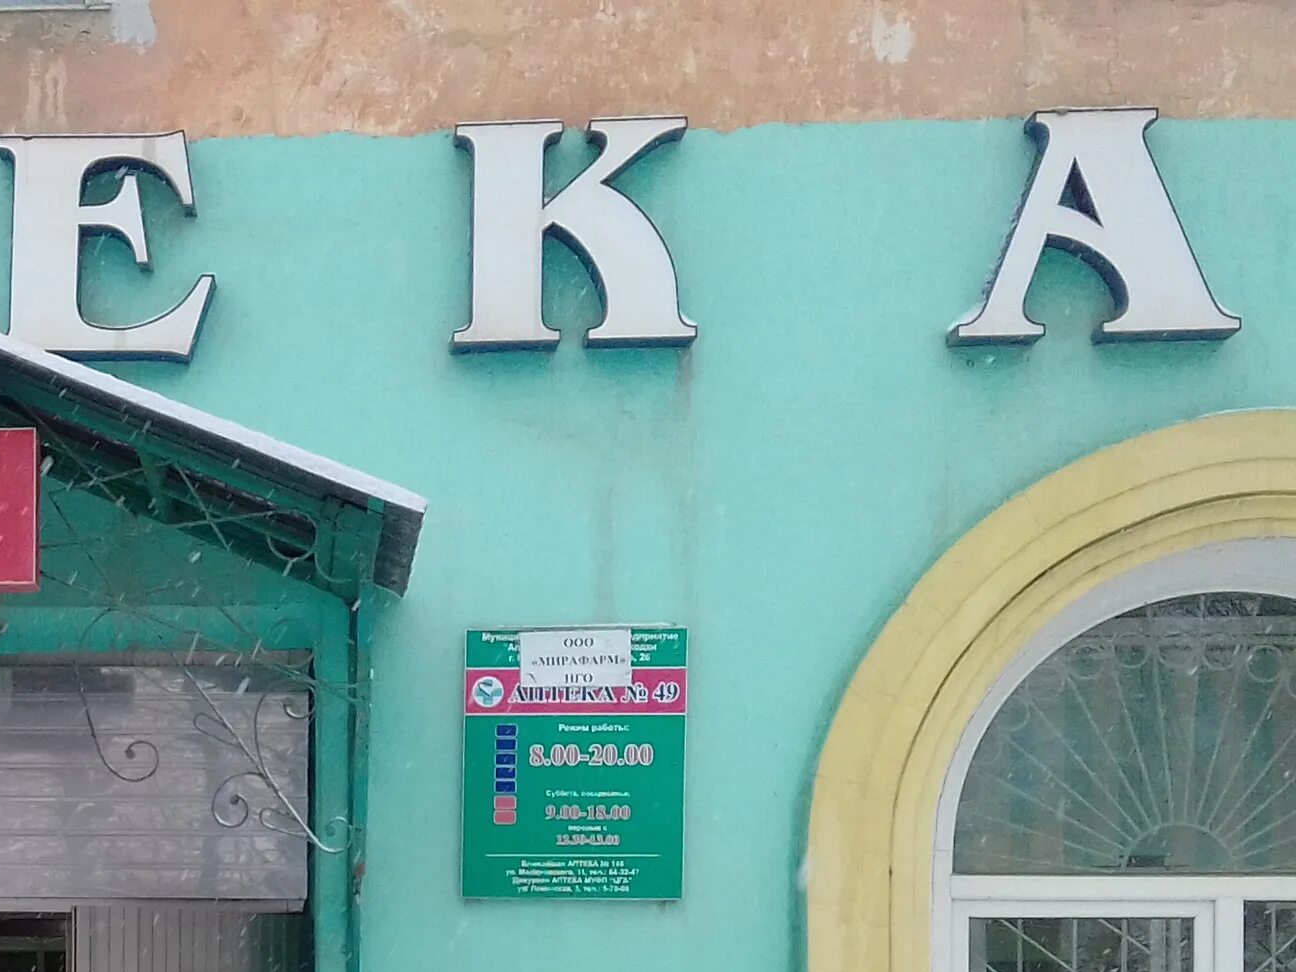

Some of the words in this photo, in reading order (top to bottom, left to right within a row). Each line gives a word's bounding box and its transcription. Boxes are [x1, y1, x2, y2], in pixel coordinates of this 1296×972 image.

[563, 637, 594, 648] ООО
[653, 682, 680, 703] 49
[529, 744, 654, 767] 8.00-20.00
[545, 804, 632, 820] 9.00-18.00
